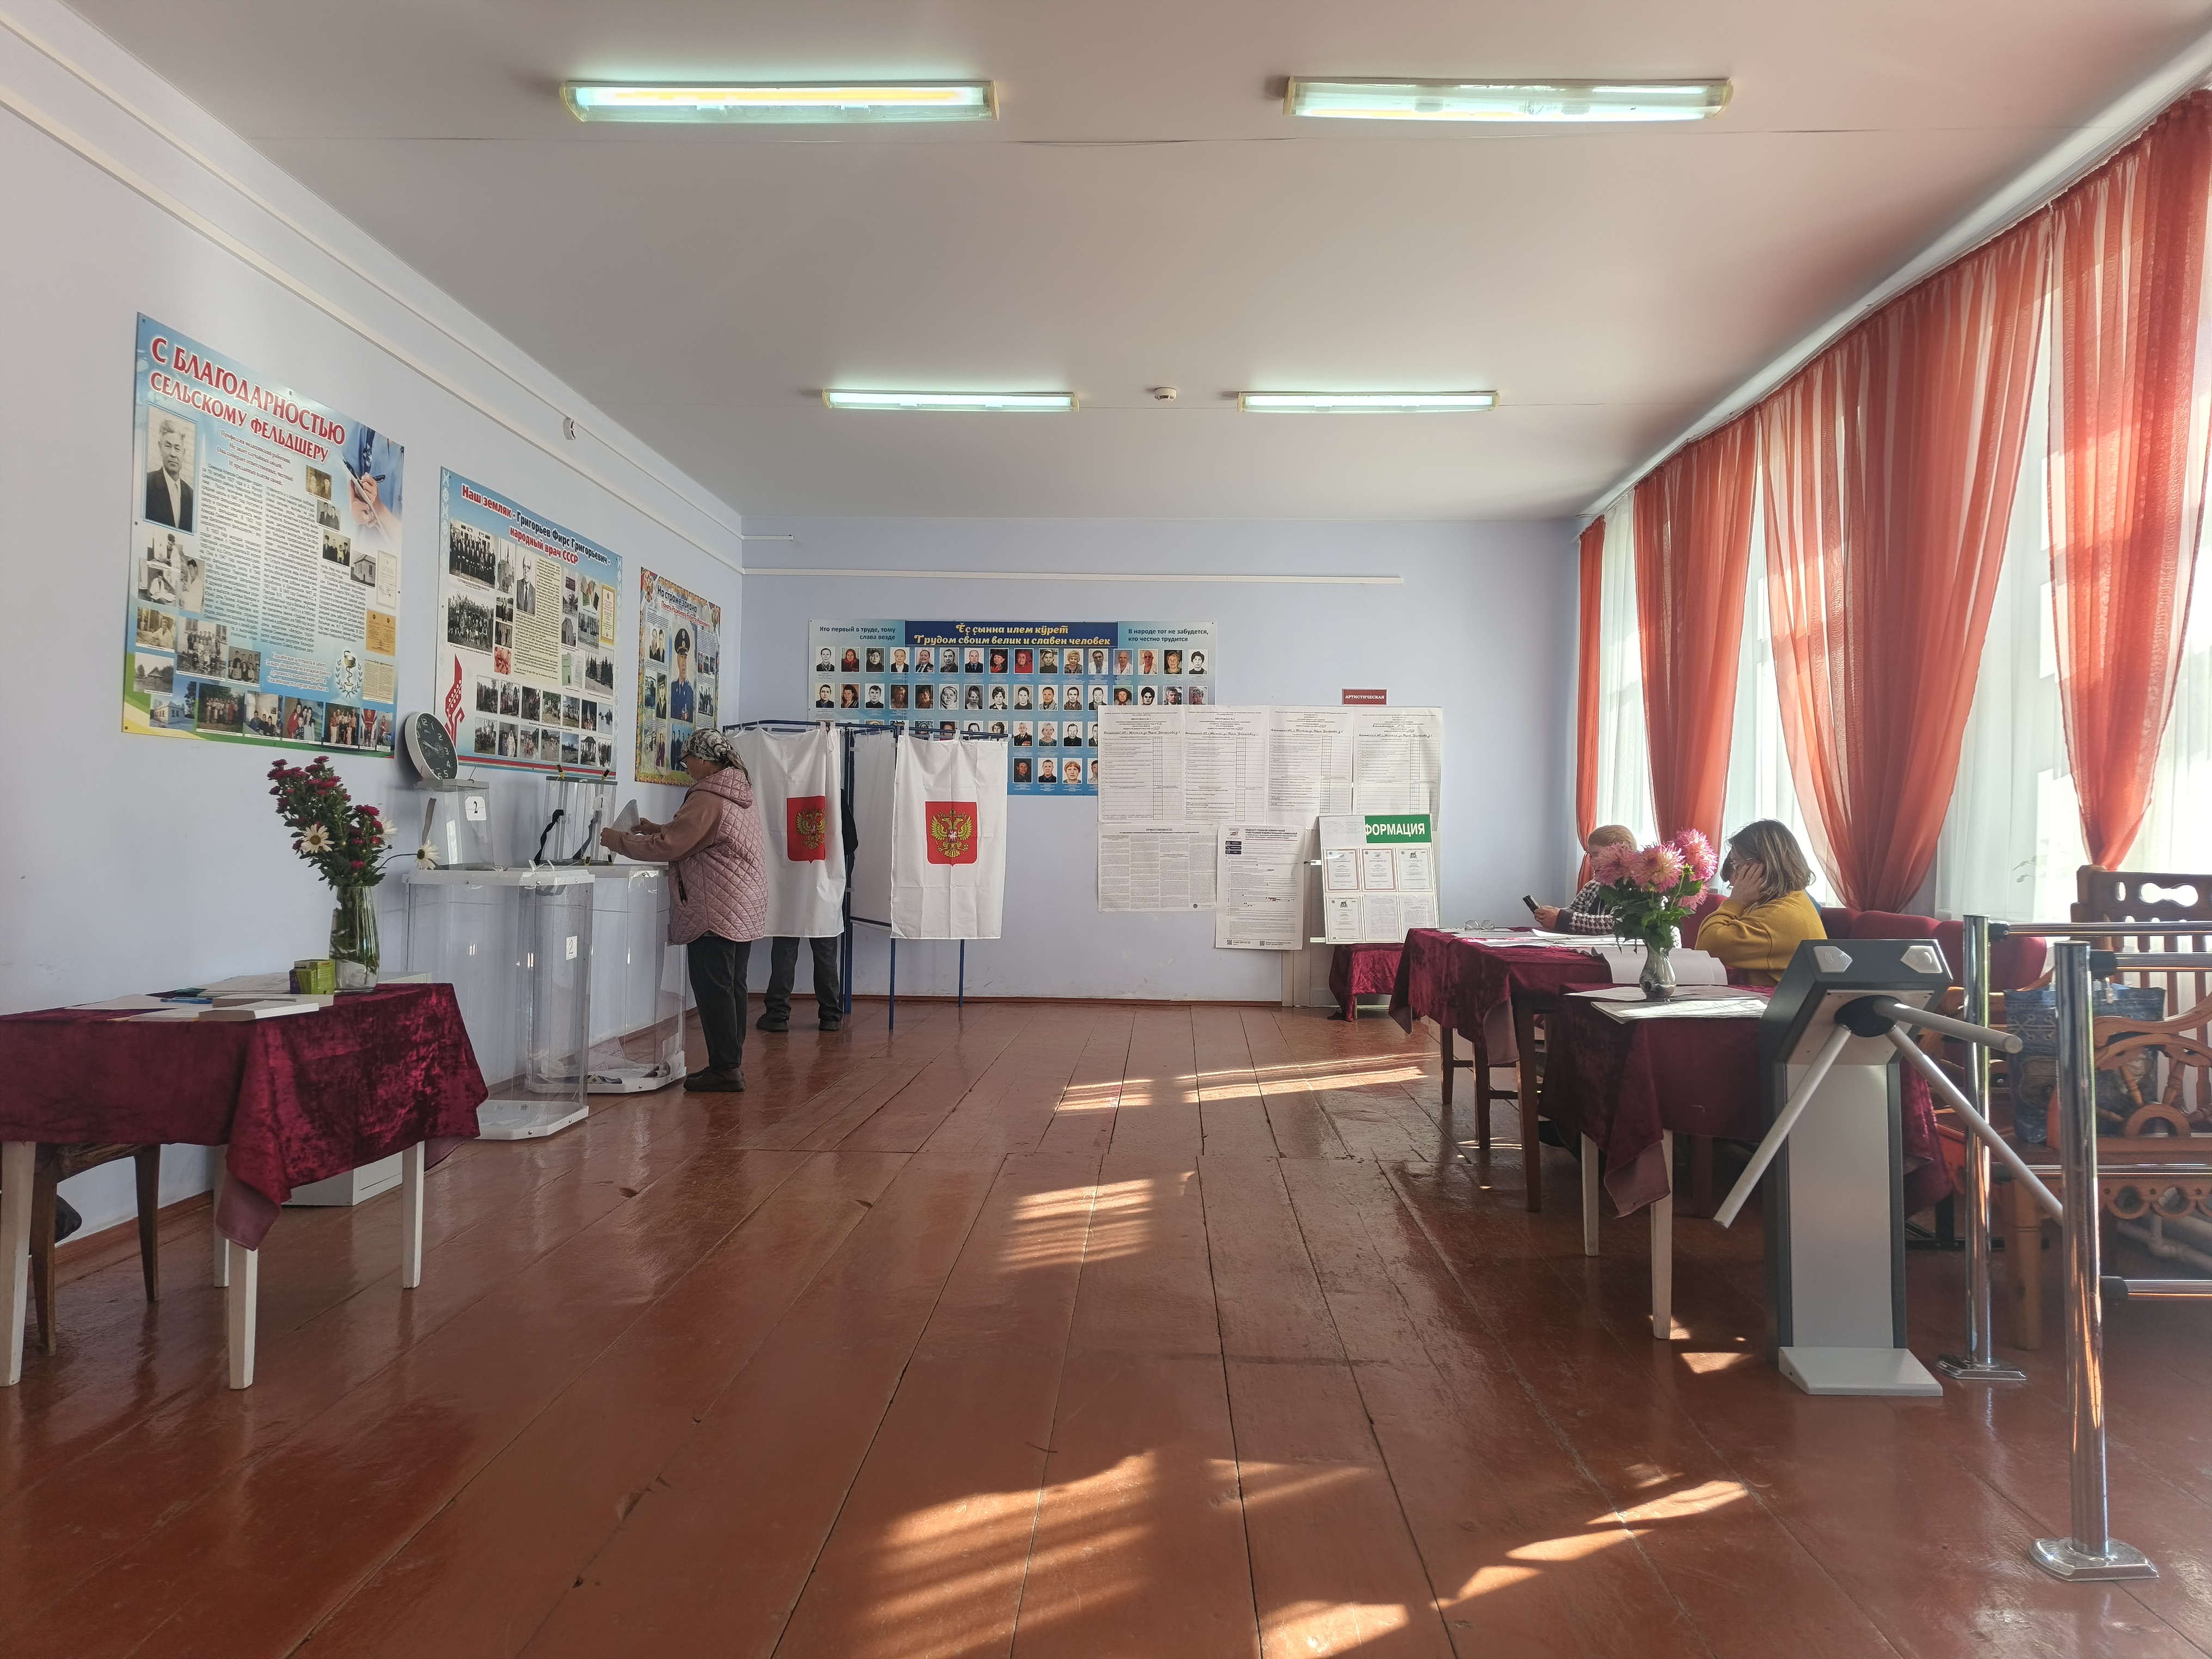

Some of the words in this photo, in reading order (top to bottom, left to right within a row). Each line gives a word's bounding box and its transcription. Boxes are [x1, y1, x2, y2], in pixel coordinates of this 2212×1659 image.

[150, 337, 167, 364] С
[173, 345, 346, 446] БЛАГОДАРНОСТЬЮ
[150, 372, 248, 427] СЕЛЬСКОМУ
[250, 418, 329, 464] ФЕЛЬДШЕРУ
[462, 484, 481, 504] Наш
[483, 497, 512, 518] земляк
[517, 512, 551, 538] Григорьев
[552, 529, 570, 548] Фирс
[572, 537, 607, 564] Григорьевич
[509, 527, 543, 550] народный
[544, 544, 561, 559] врач
[562, 551, 579, 564] СССР
[657, 585, 664, 597] На
[665, 592, 681, 605] страже
[681, 599, 697, 612] закона
[914, 635, 956, 646] Трудом
[958, 636, 990, 644] своим
[991, 636, 1021, 644] велик
[1069, 637, 1110, 645] человек
[421, 718, 428, 726] 12
[437, 733, 443, 741] 2
[444, 747, 449, 755] 3
[443, 770, 449, 778] 5
[473, 801, 478, 814] 2
[1365, 823, 1425, 837] ФОРМАЦИЯ
[568, 939, 574, 955] 2
